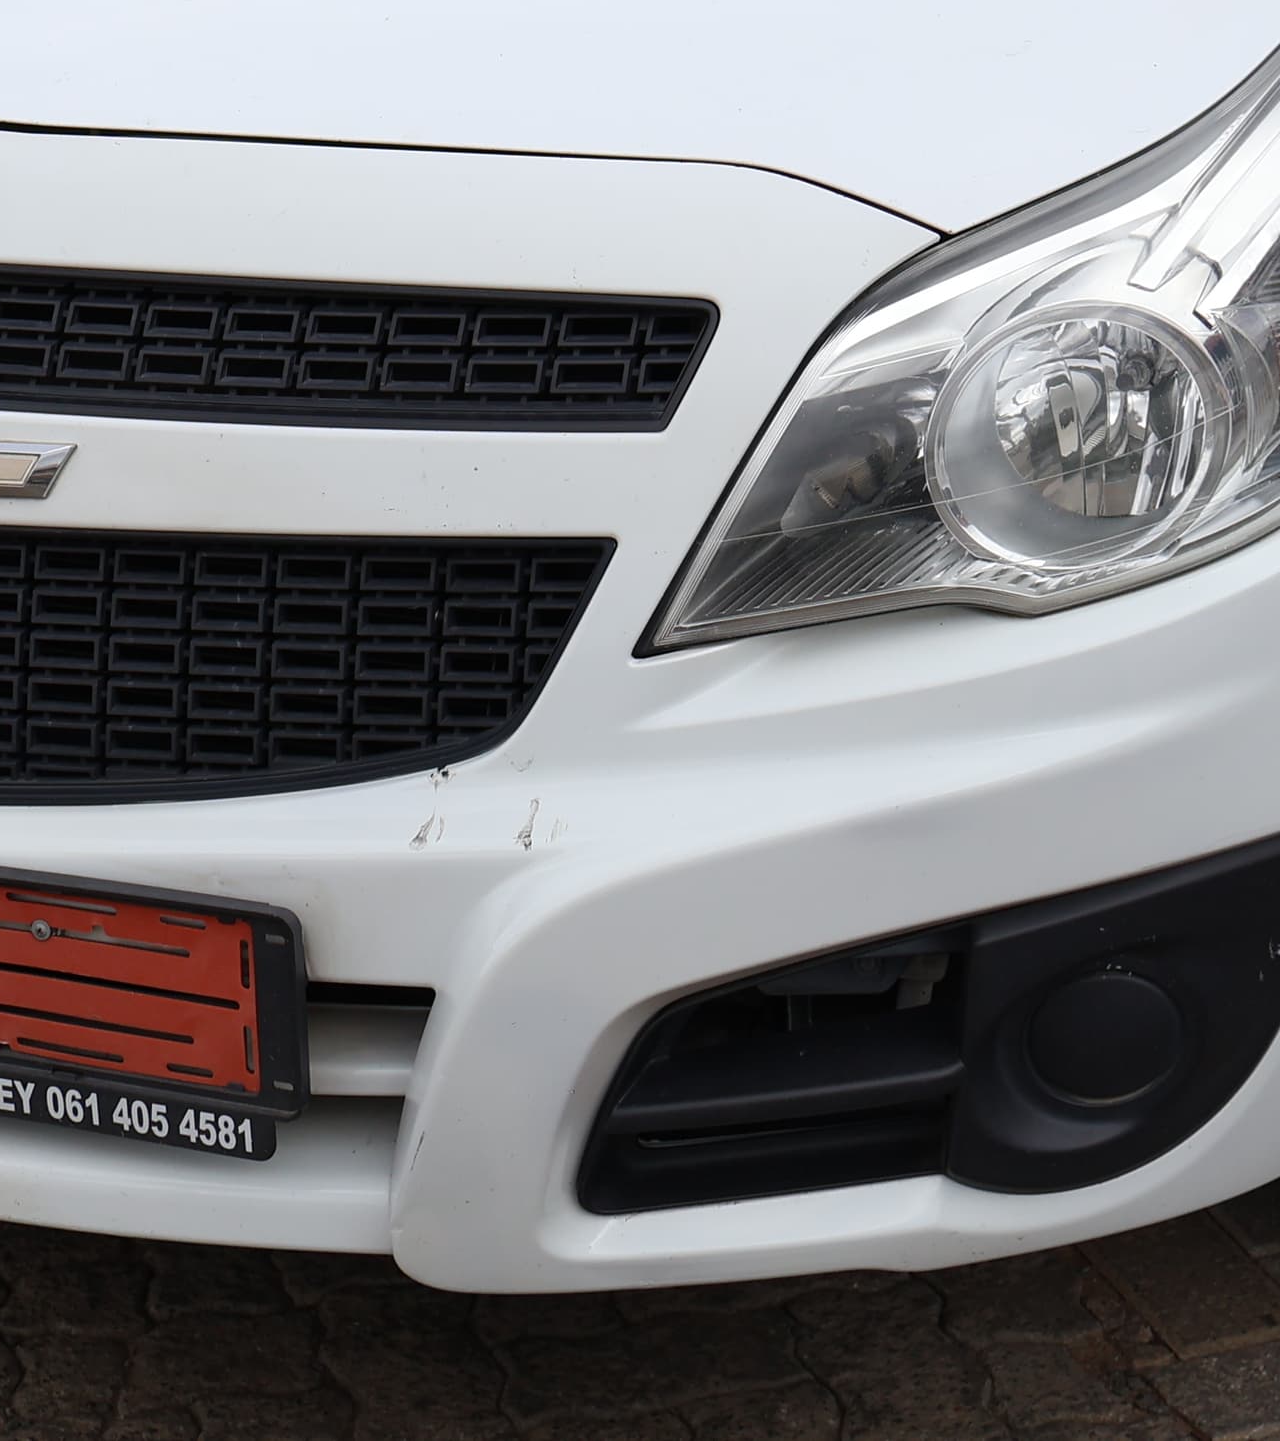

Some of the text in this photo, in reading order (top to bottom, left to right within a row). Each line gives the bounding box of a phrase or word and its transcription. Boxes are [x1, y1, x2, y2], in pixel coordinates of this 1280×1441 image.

[46, 1085, 100, 1127] 061
[112, 1096, 170, 1139] 405
[179, 1108, 254, 1154] 4581
